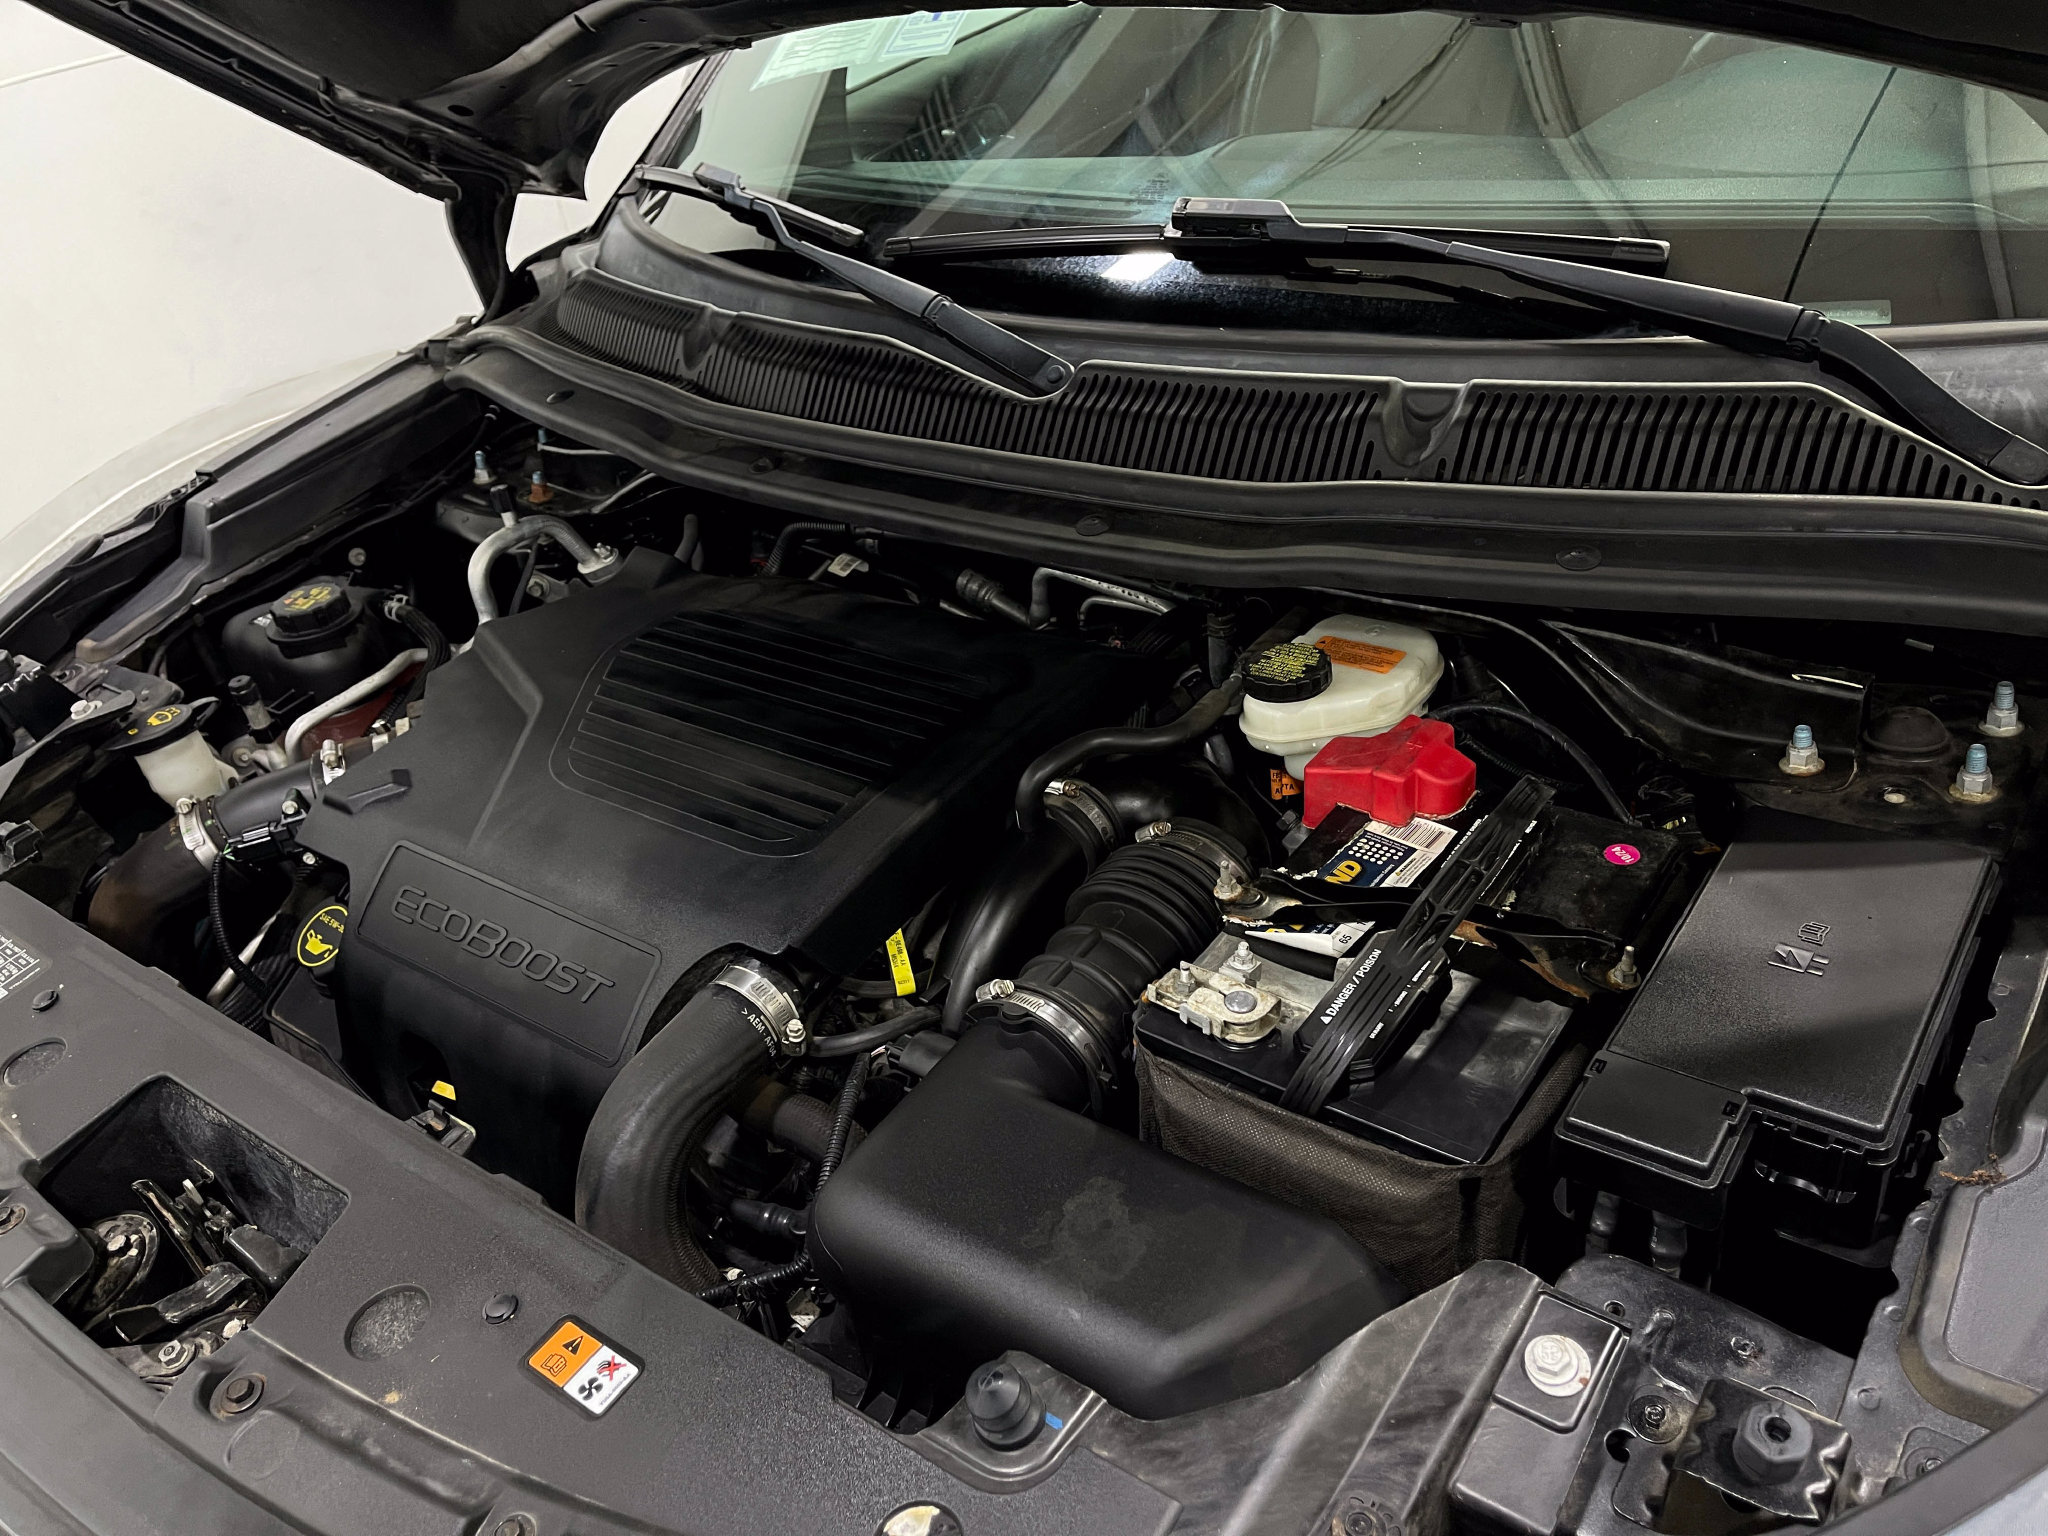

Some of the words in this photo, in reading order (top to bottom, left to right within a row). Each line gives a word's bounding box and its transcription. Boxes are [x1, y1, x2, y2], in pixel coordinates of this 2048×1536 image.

[1338, 934, 1352, 944] 65
[1325, 982, 1356, 1017] DANGER
[1357, 948, 1382, 978] POISON
